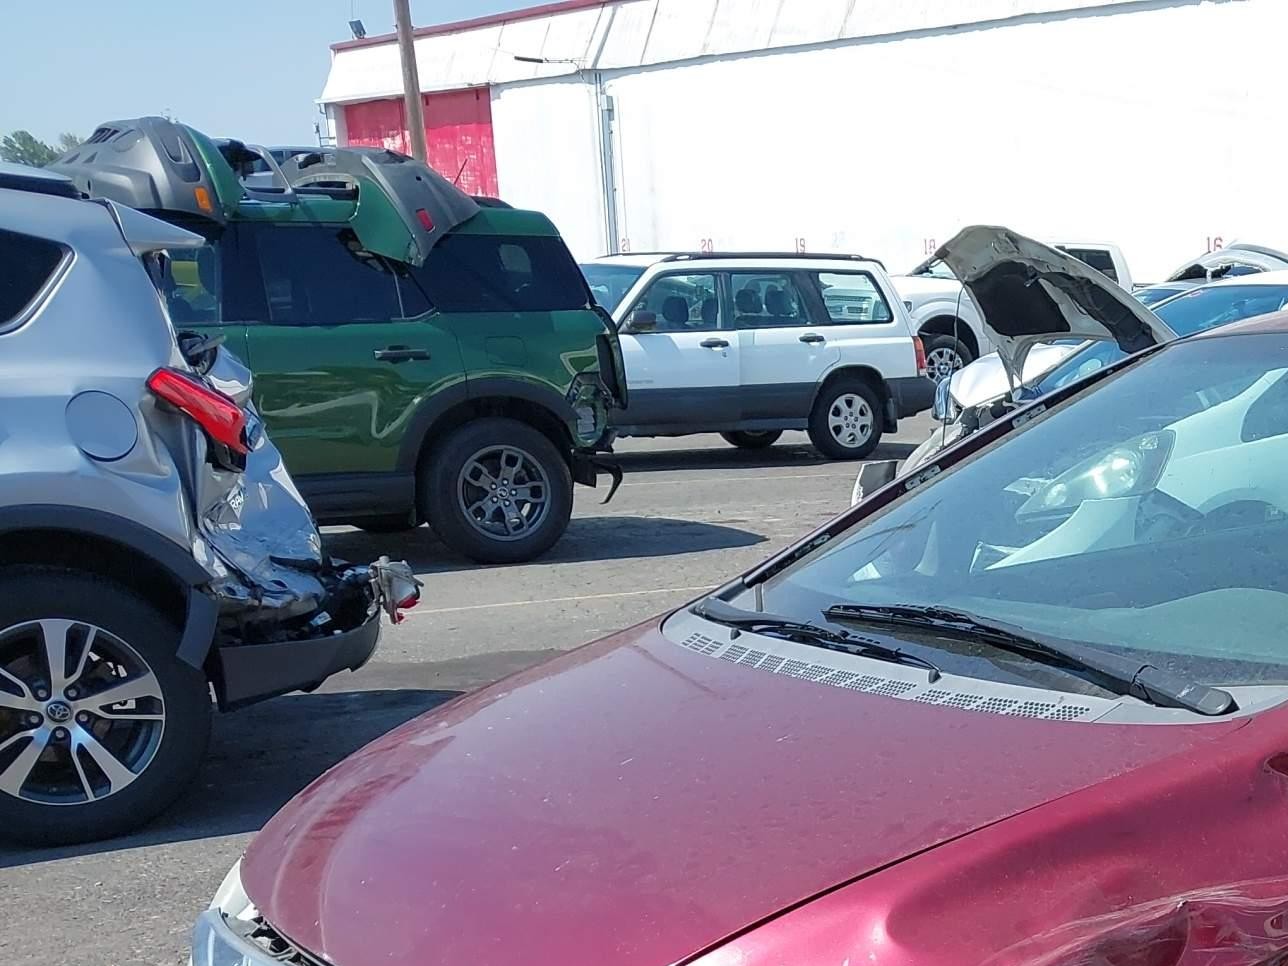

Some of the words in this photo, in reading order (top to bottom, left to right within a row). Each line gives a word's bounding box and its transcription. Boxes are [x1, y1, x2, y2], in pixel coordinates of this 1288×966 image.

[701, 238, 713, 253] 20
[795, 237, 806, 254] 19
[1206, 236, 1223, 251] 16
